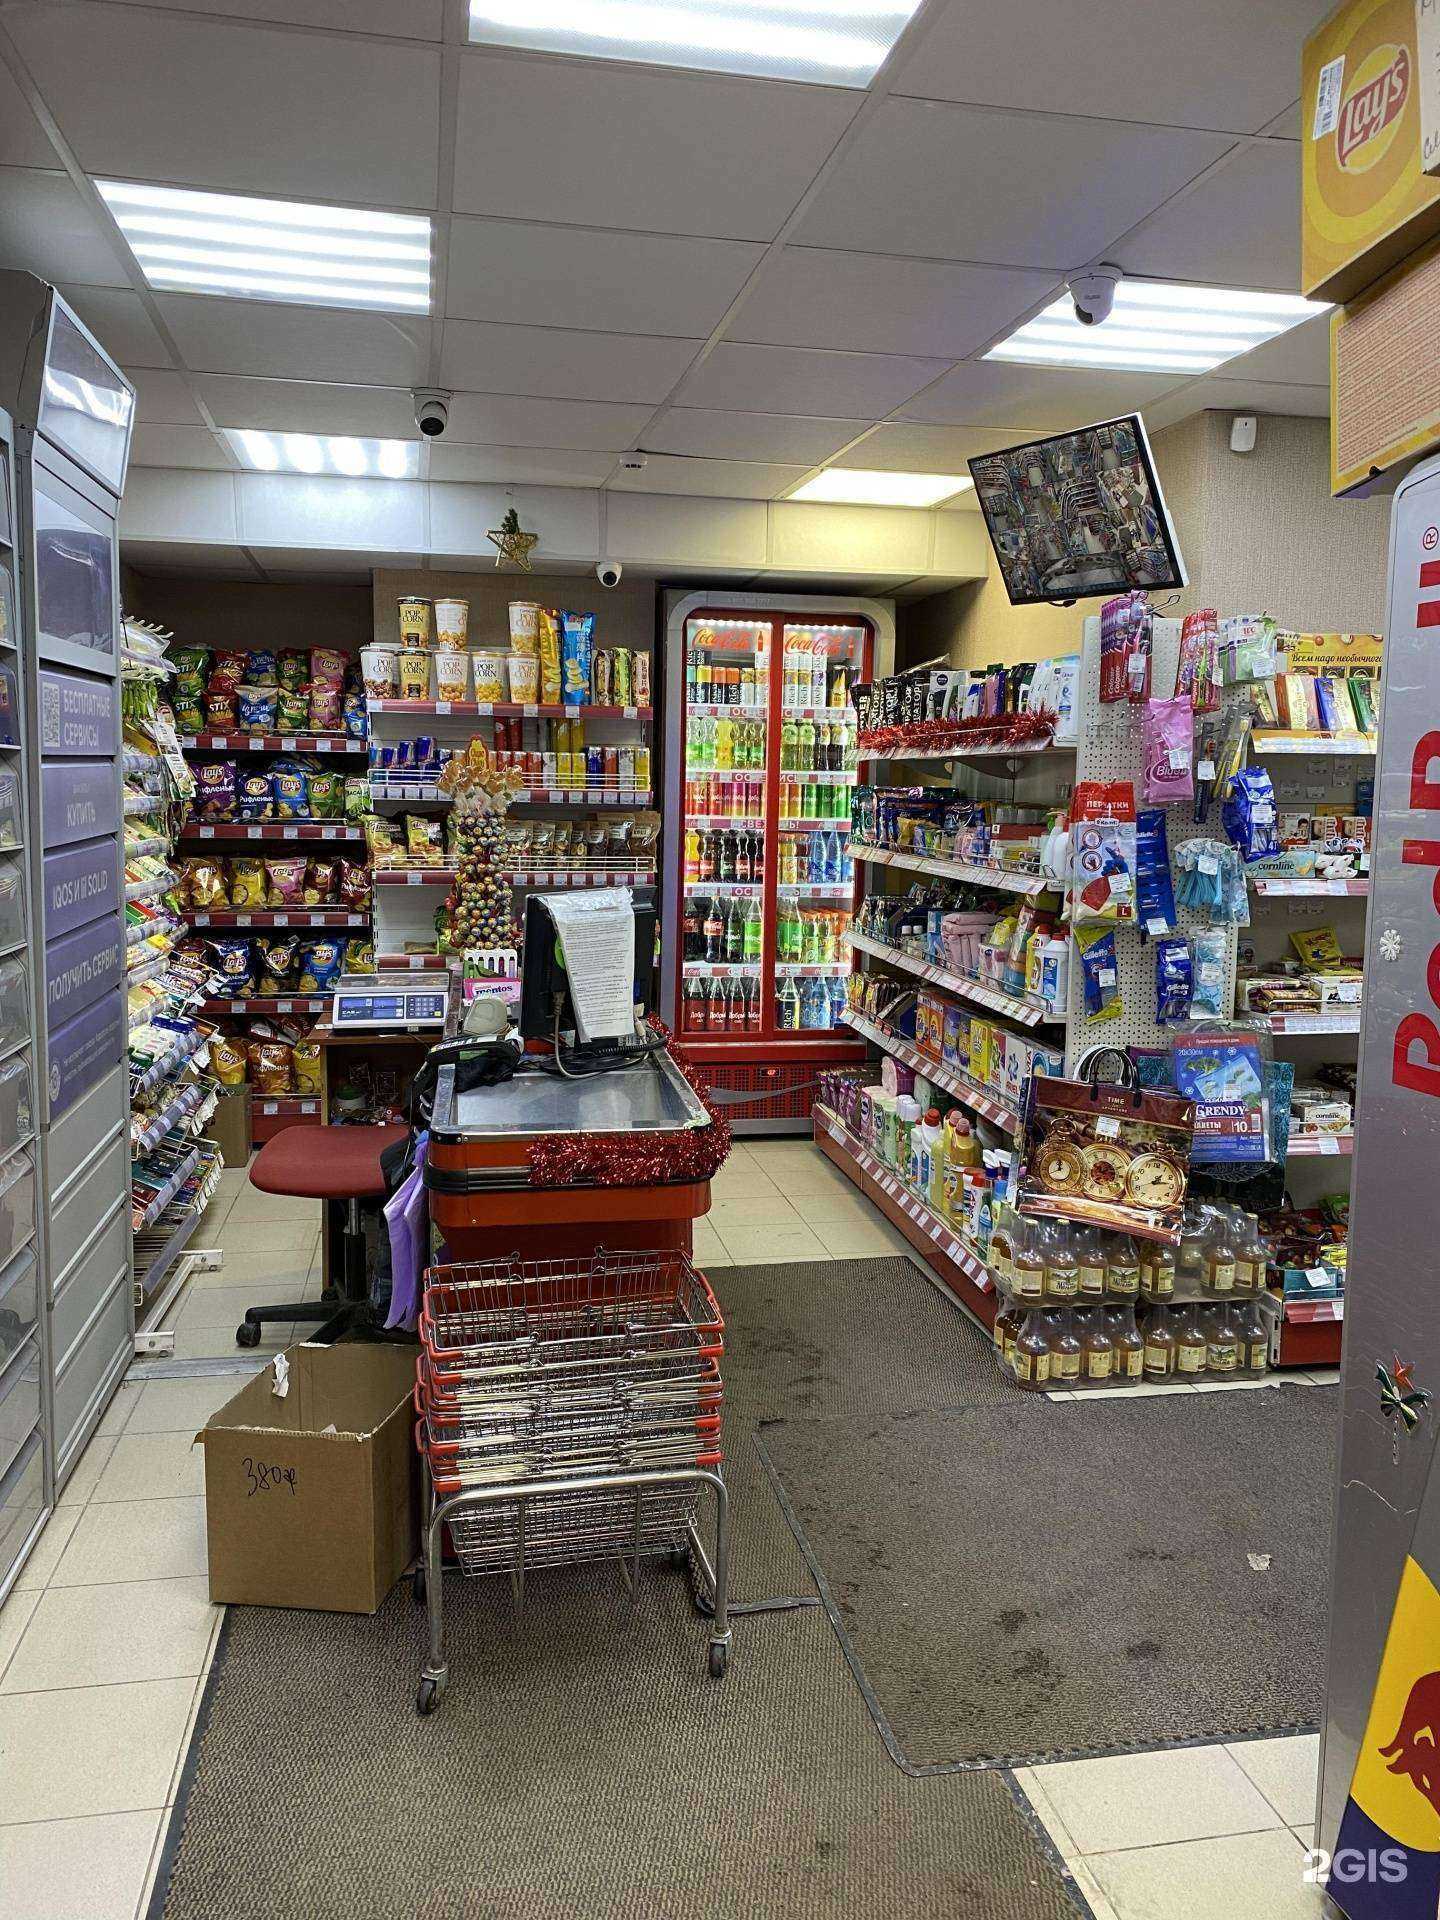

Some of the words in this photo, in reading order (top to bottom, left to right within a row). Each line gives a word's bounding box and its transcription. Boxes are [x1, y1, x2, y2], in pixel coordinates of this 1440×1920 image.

[1292, 654, 1313, 662] Всем
[63, 690, 111, 718] БЕСПЛАТНЫЕ
[209, 700, 230, 711] STIX
[64, 723, 99, 747] СЕРВИСЫ
[66, 802, 96, 828] КУПИТЬ
[53, 881, 73, 910] IQOS
[88, 870, 108, 897] SOLID
[48, 961, 92, 1004] ПОЛУЧИТЬ
[92, 944, 119, 977] СЕРВИС
[783, 1008, 793, 1029] Rich
[1107, 1096, 1125, 1104] TIME
[1195, 1104, 1246, 1116] GRENDY
